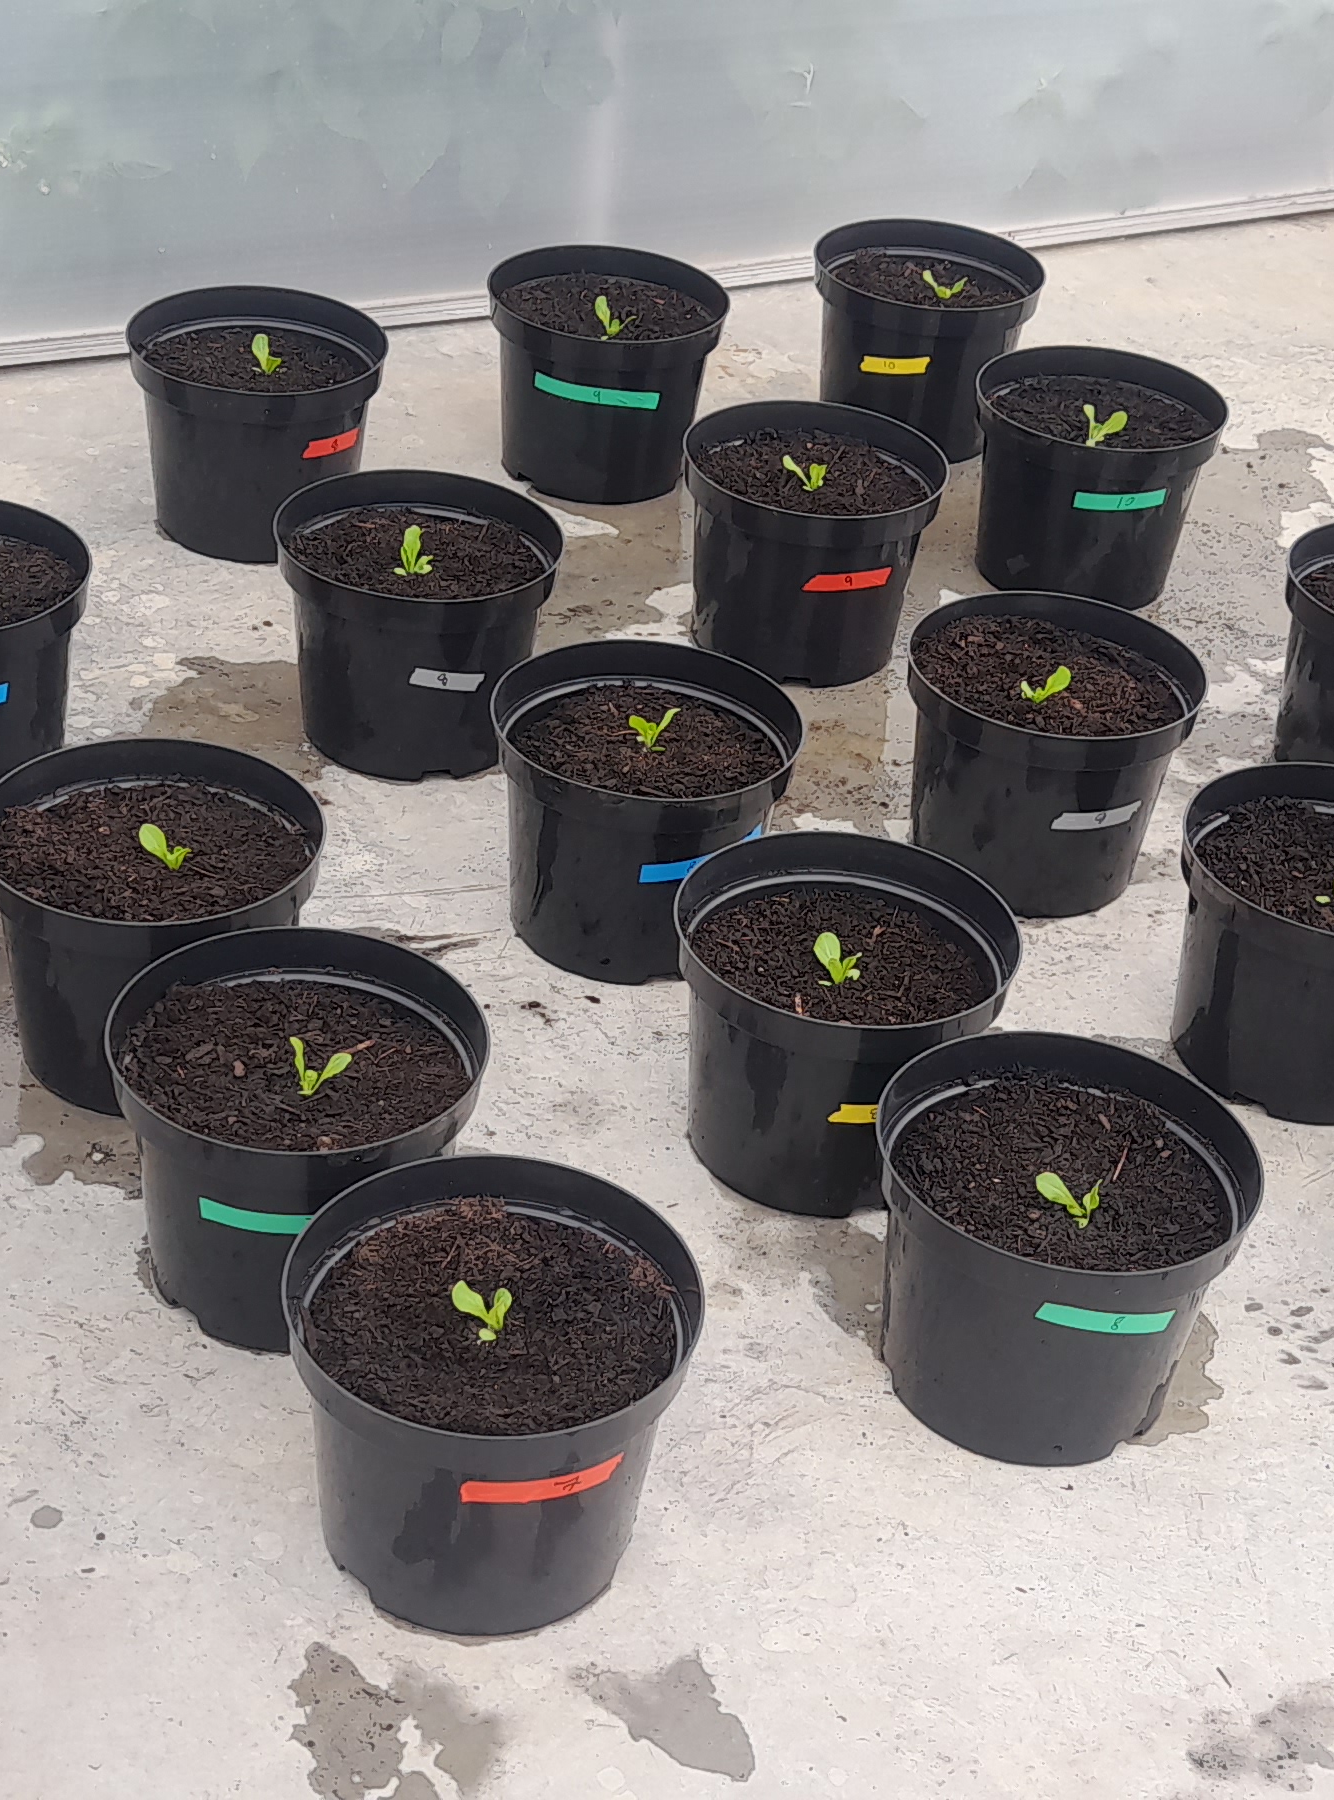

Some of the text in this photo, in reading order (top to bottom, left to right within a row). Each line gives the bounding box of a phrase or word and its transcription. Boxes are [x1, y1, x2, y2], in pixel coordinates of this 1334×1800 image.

[882, 360, 896, 371] 10
[592, 390, 602, 403] 9
[1116, 496, 1136, 509] 10
[843, 574, 854, 588] 9
[436, 672, 449, 687] 8
[1094, 812, 1108, 826] 9
[1109, 1315, 1127, 1332] 8
